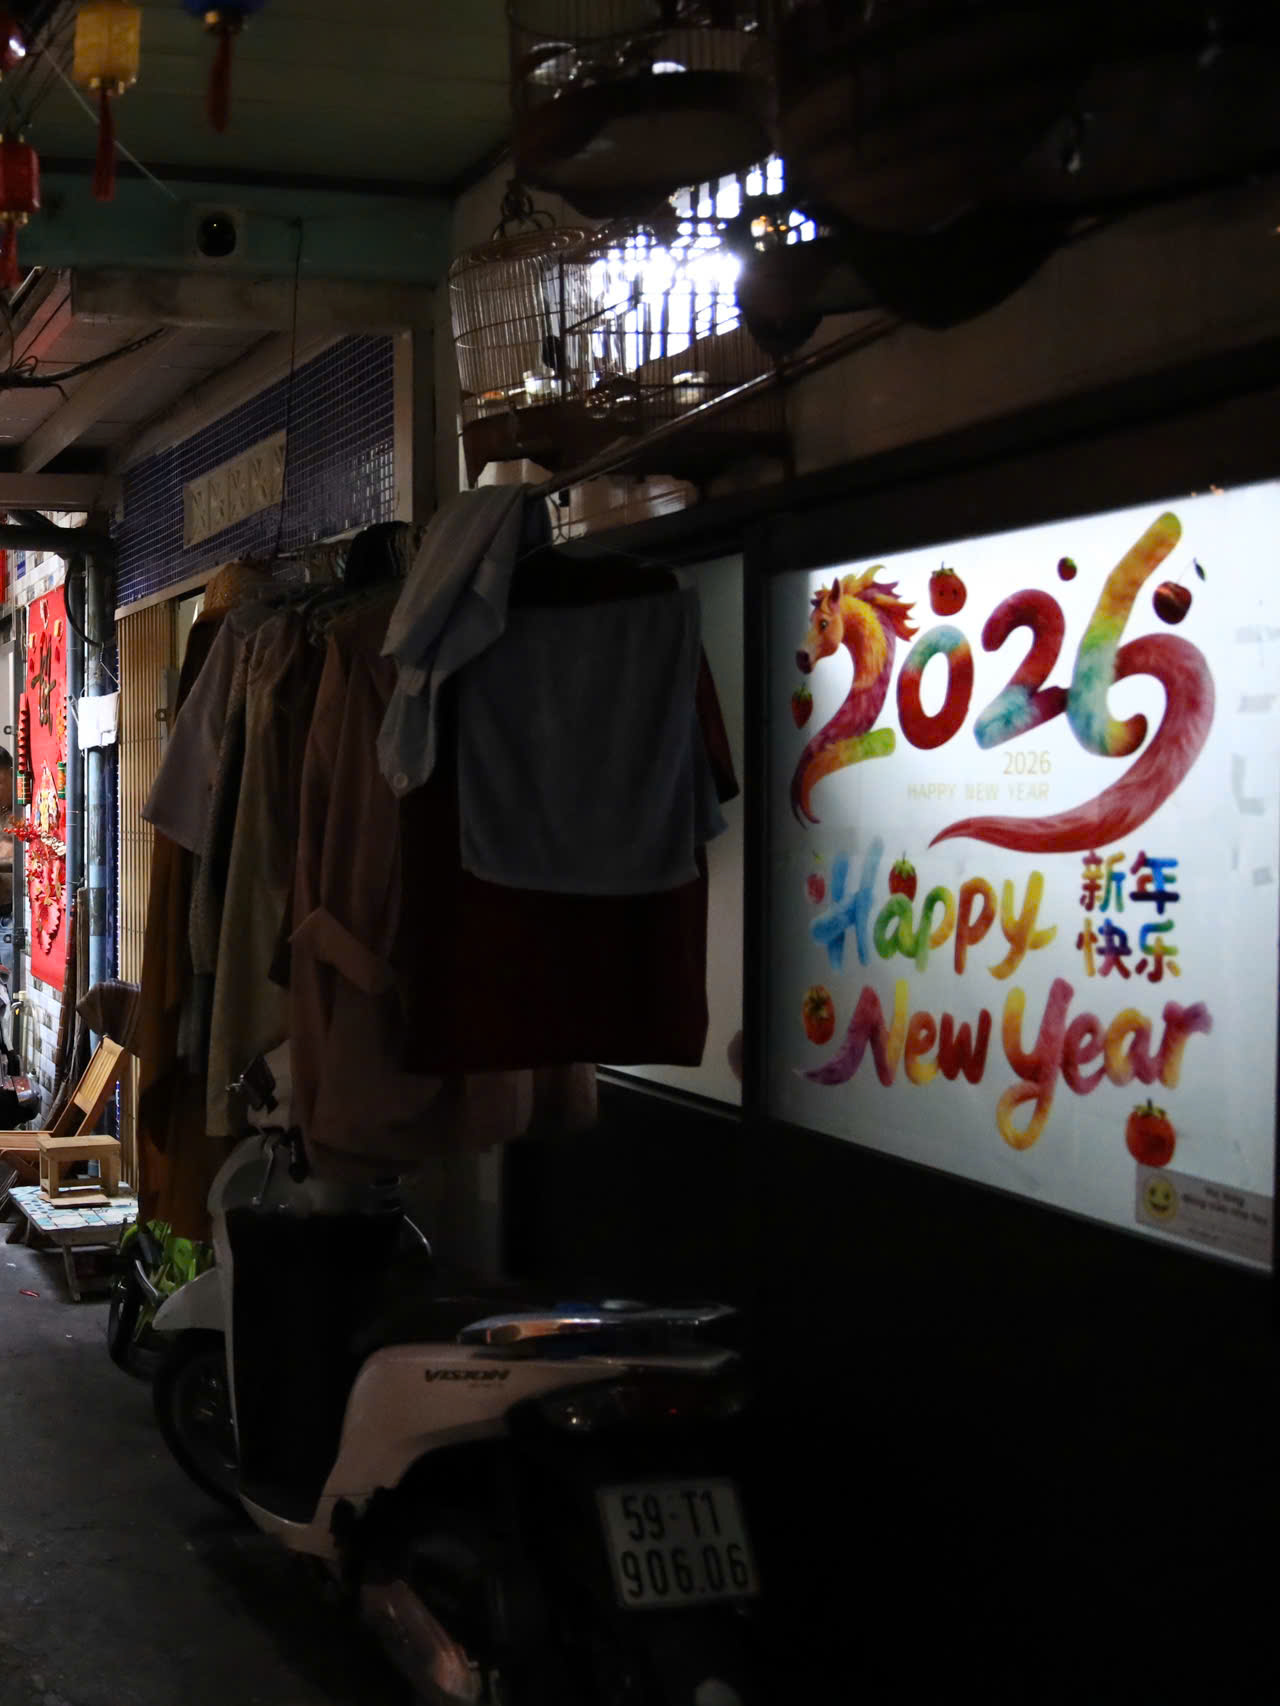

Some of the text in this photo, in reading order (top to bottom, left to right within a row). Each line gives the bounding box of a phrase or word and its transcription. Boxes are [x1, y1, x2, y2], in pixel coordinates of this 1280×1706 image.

[791, 512, 1215, 854] 2026
[907, 782, 1050, 801] HAPPY NEW YEAR
[1003, 751, 1052, 775] 2026
[811, 837, 1057, 980] Happy
[1079, 850, 1180, 914] 新年
[1076, 918, 1181, 983] 快乐
[797, 977, 1213, 1151] New Year
[425, 1369, 511, 1383] VISION
[622, 1490, 721, 1542] 59-T1
[620, 1543, 748, 1598] 906.06
